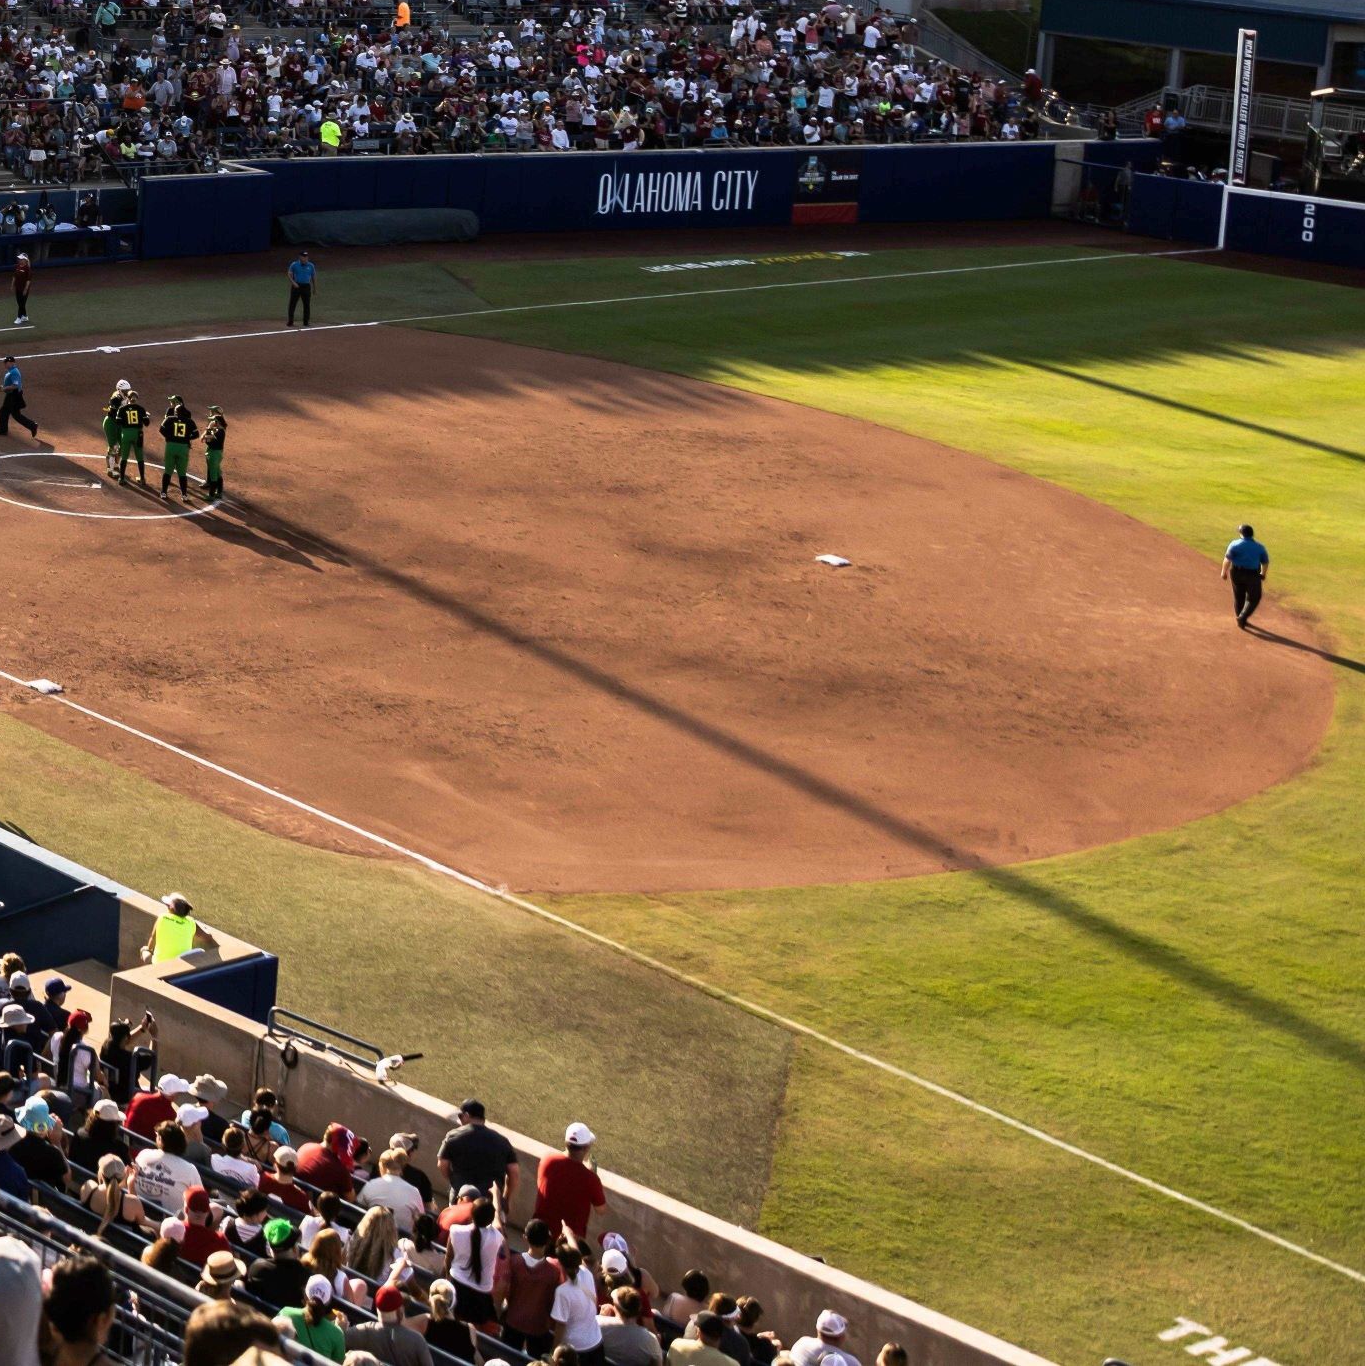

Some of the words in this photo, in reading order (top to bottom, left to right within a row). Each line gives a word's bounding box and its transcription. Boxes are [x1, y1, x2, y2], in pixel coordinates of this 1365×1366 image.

[1244, 39, 1254, 58] NCAA
[1241, 58, 1252, 93] WOMEN'S
[1239, 92, 1250, 125] COLLEGE
[1237, 124, 1248, 151] WORLD
[1235, 149, 1245, 174] SERIES
[595, 162, 702, 214] OKLAHOMA
[712, 170, 759, 211] CITY
[1302, 203, 1315, 242] 200
[126, 410, 139, 425] 18
[174, 422, 187, 438] 13
[1158, 1316, 1283, 1366] TH
